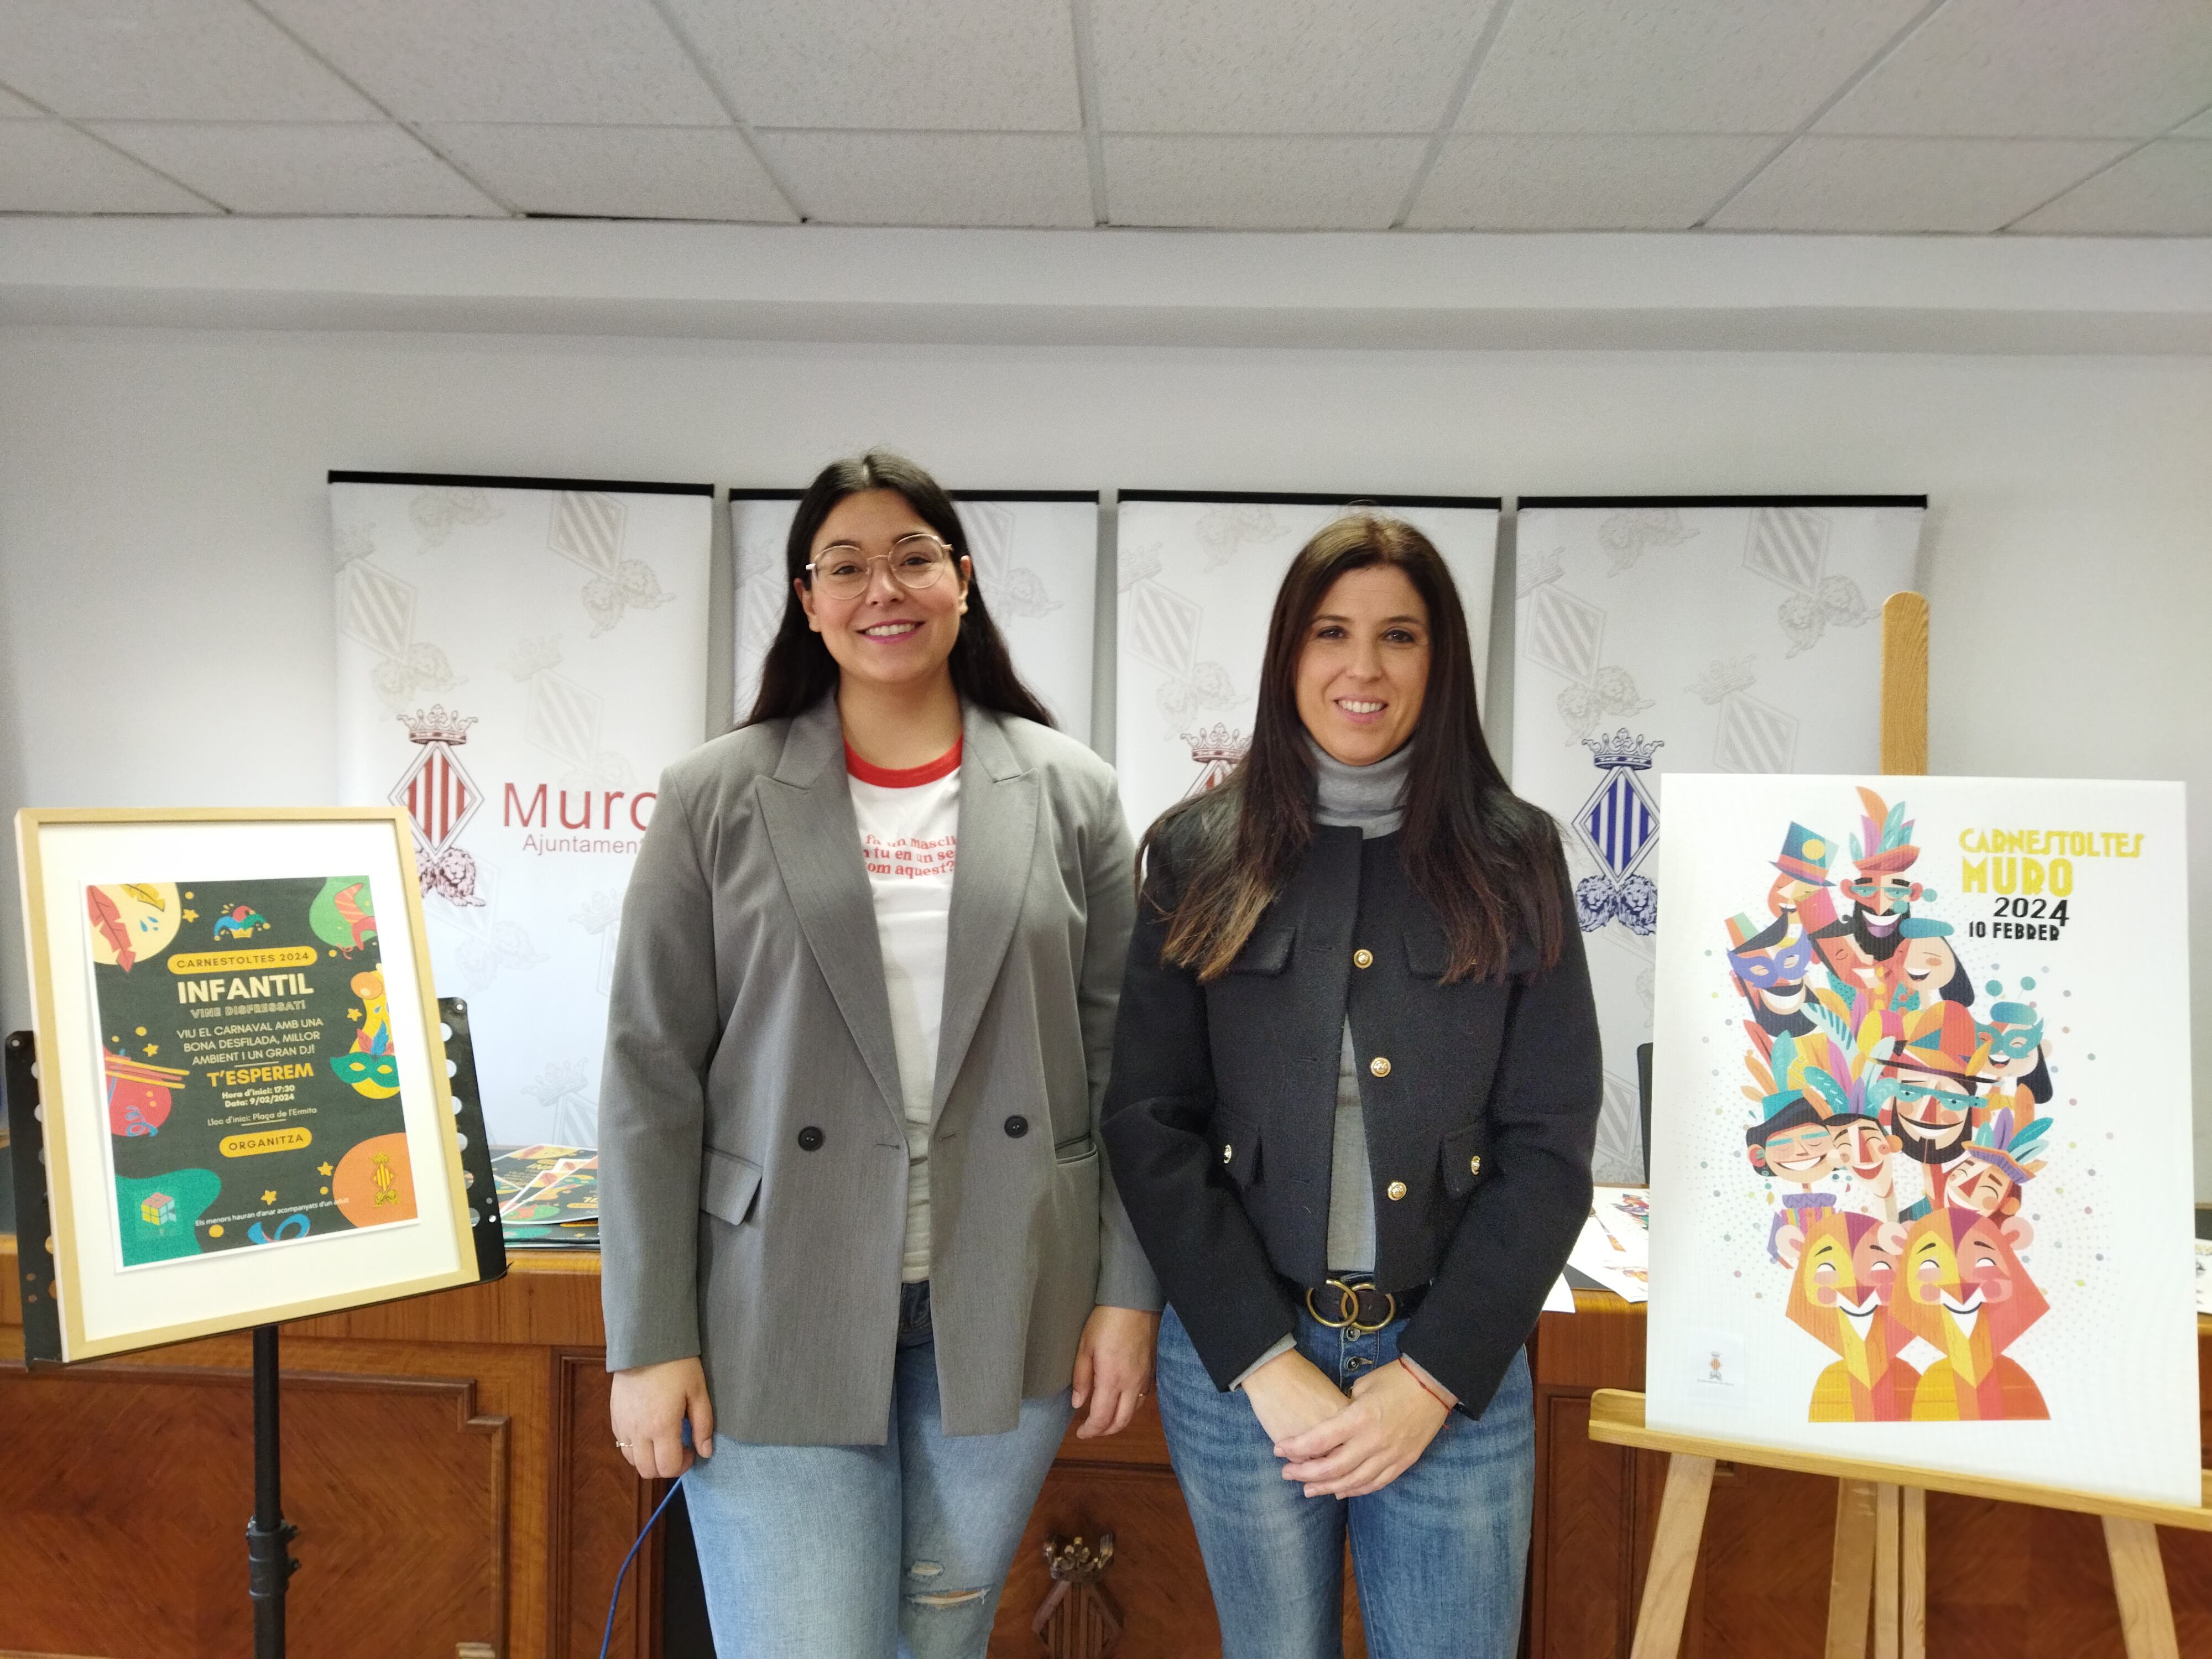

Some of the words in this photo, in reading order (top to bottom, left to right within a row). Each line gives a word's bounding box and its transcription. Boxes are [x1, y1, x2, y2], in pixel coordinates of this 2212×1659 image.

[523, 834, 641, 855] Ajuntamen
[874, 847, 890, 858] tu
[895, 850, 912, 860] en
[917, 853, 933, 863] un
[937, 850, 955, 860] se
[867, 863, 891, 874] om
[895, 860, 956, 879] aquest?
[1961, 856, 2073, 898] MURO
[1993, 897, 2069, 926] 2024
[1969, 921, 1986, 937] 10
[1992, 922, 2060, 941] FEBRER
[176, 954, 275, 968] CARNESTOLTES
[279, 952, 310, 961] 2024
[177, 973, 315, 1004] INFANTIL
[190, 1007, 221, 1019] VINE
[176, 1029, 196, 1039] VIU
[199, 1027, 212, 1037] EL
[213, 1022, 273, 1036] CARNAVAL
[275, 1020, 299, 1031] AMB
[300, 1018, 324, 1027] UNA
[184, 1041, 216, 1052] BONA
[218, 1035, 280, 1049] DESFILADA,
[282, 1031, 321, 1044] MILLOR
[192, 1051, 238, 1066] AMBIENT
[241, 1051, 246, 1061] I
[247, 1049, 263, 1060] UN
[265, 1046, 297, 1057] GRAN
[299, 1044, 315, 1055] DJ!
[206, 1062, 315, 1087] T'ESPEREM
[221, 1091, 243, 1099] Hora
[274, 1084, 296, 1093] 17:30
[225, 1098, 248, 1108] Data:
[249, 1093, 295, 1106] 9/02/2024
[252, 1112, 275, 1121] Plaça
[228, 1134, 304, 1151] ORGANITZA
[206, 1216, 232, 1225] menors
[232, 1213, 255, 1221] hauran
[276, 1202, 319, 1215] acompanyats
